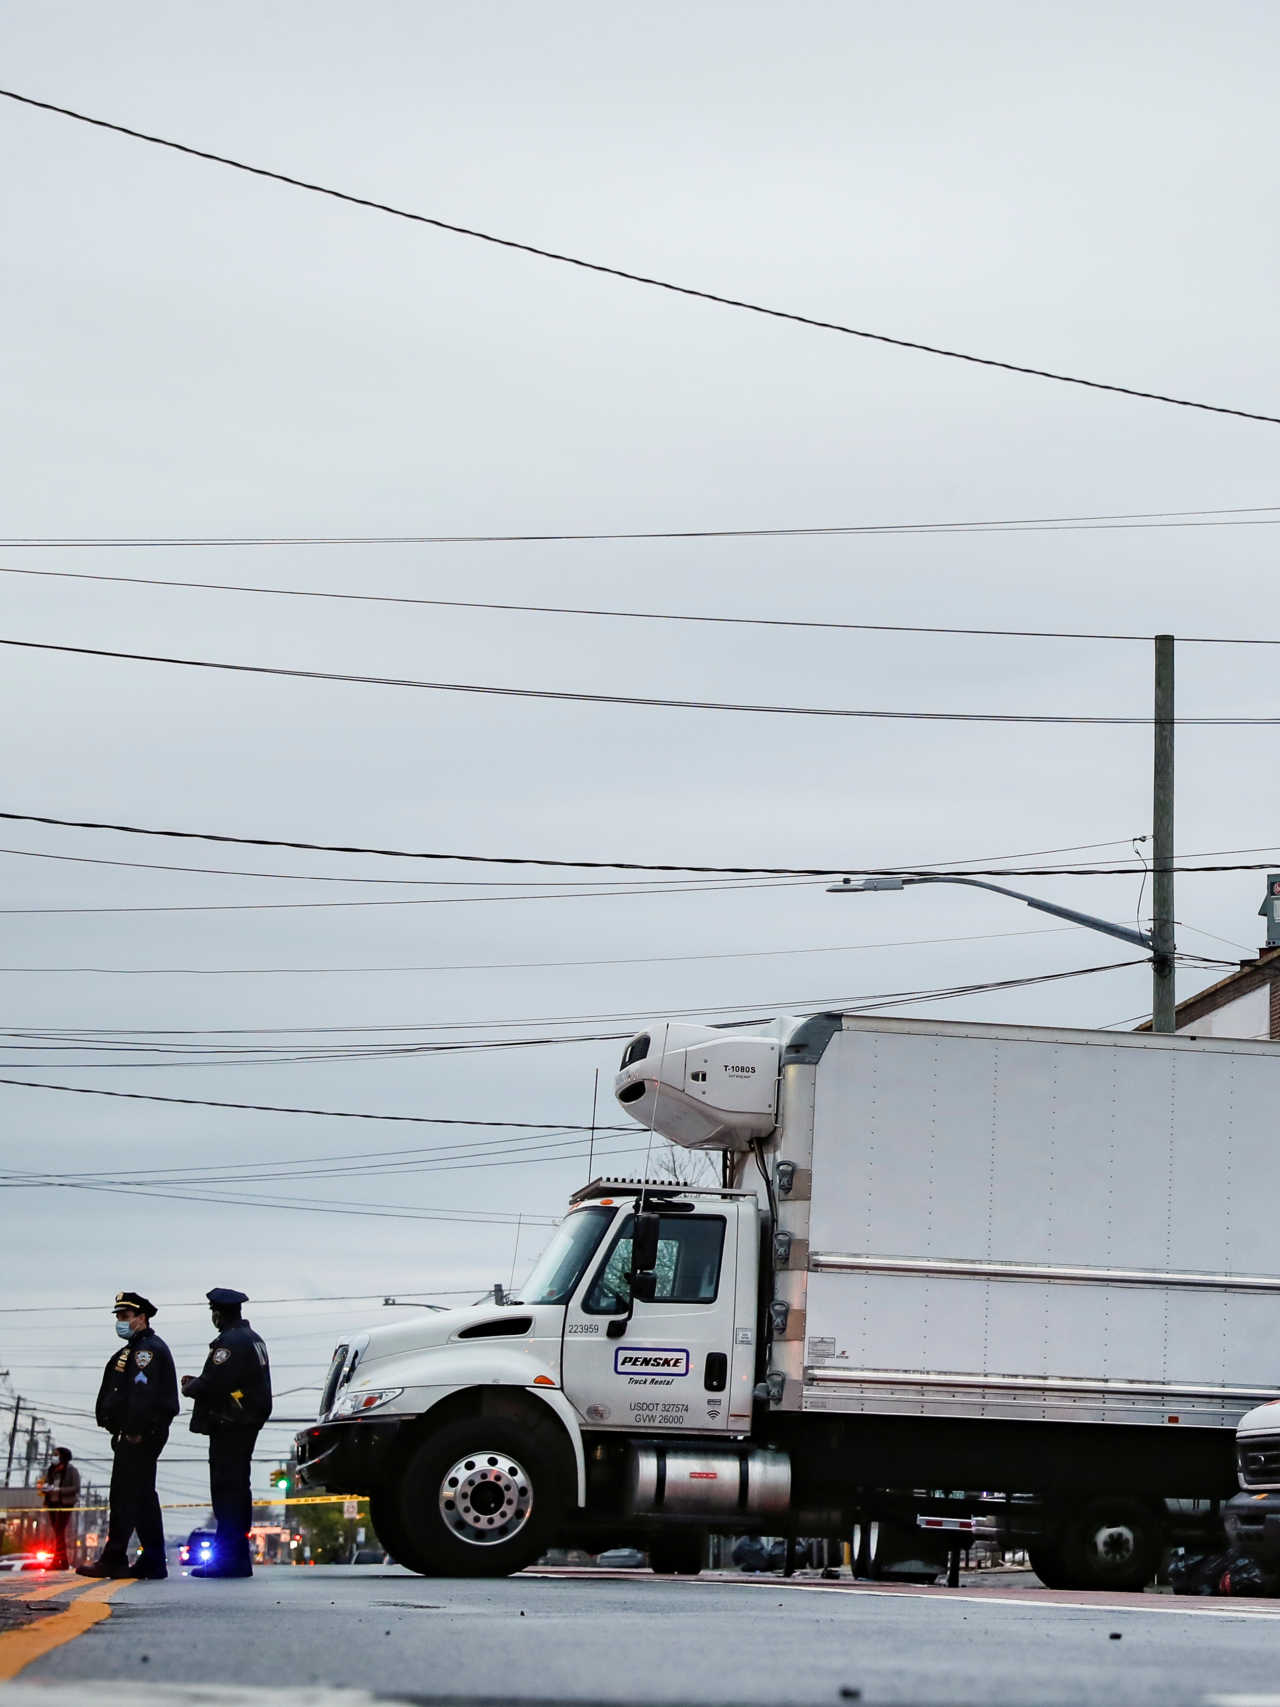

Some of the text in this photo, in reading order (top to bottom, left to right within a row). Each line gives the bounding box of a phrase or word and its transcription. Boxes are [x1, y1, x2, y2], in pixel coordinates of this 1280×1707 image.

[724, 1065, 756, 1074] T-1080S
[568, 1324, 599, 1334] 223959
[620, 1356, 684, 1367] PENSKE
[628, 1377, 674, 1386] Truck Rental
[630, 1402, 689, 1413] USDOT 327574
[635, 1414, 684, 1425] GVW 26000
